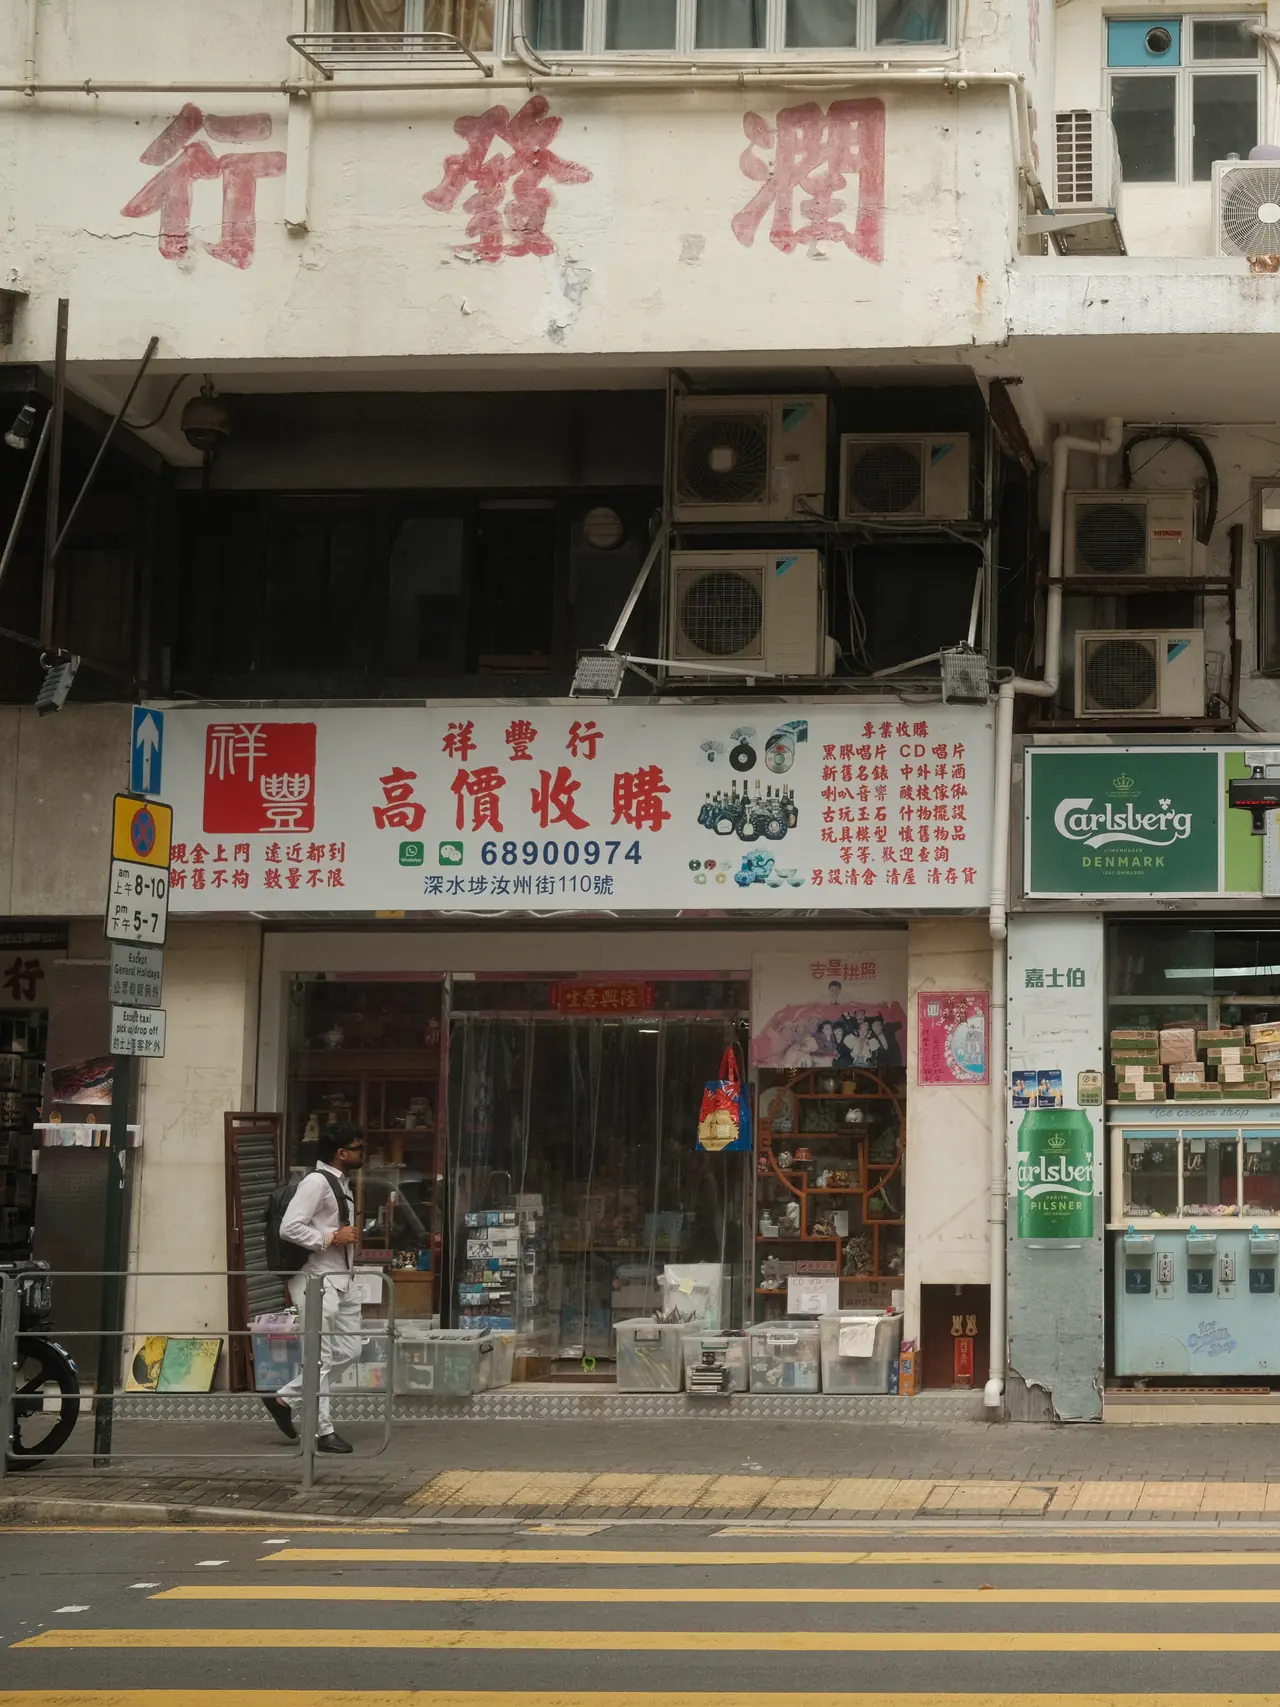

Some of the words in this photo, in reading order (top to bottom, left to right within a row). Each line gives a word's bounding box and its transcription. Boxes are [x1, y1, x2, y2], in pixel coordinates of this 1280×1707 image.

[861, 720, 929, 739] 專業收購
[442, 720, 604, 761] 祥豐行
[822, 744, 888, 761] 黑膠唱片
[900, 744, 926, 758] CD
[821, 764, 888, 782] 新舊名錶
[900, 764, 966, 781] 中外洋酒
[372, 765, 671, 832] 高價收購
[821, 784, 888, 802] 喇叭音響
[821, 806, 888, 822] 古玩玉石
[899, 804, 967, 822] 什物擺設
[1054, 798, 1192, 840] Carlsberg
[821, 826, 888, 843] 玩具模型
[899, 825, 967, 843] 懷舊物品
[170, 842, 251, 864] 現金上門
[264, 841, 346, 864] 遠近都到
[480, 840, 642, 866] 68900974
[1082, 855, 1165, 867] DENMARK
[119, 869, 130, 878] am
[169, 867, 250, 890] 新舊不拘
[264, 867, 346, 889] 數量不限
[811, 867, 878, 886] 另設清倉
[886, 867, 917, 886] 清屋
[927, 867, 977, 886] 清存貨
[114, 881, 132, 896] 上午
[134, 874, 165, 899] 8-10
[116, 905, 128, 915] pm
[112, 917, 131, 932] 下午
[114, 963, 136, 977] General
[136, 966, 160, 981] Holidays
[1025, 967, 1085, 988] 嘉士伯
[140, 1013, 152, 1023] taxi
[117, 1024, 127, 1034] pick
[149, 1026, 159, 1035] off
[1177, 1108, 1217, 1117] cream
[1220, 1107, 1249, 1118] shop
[1031, 1202, 1082, 1210] PILSNER
